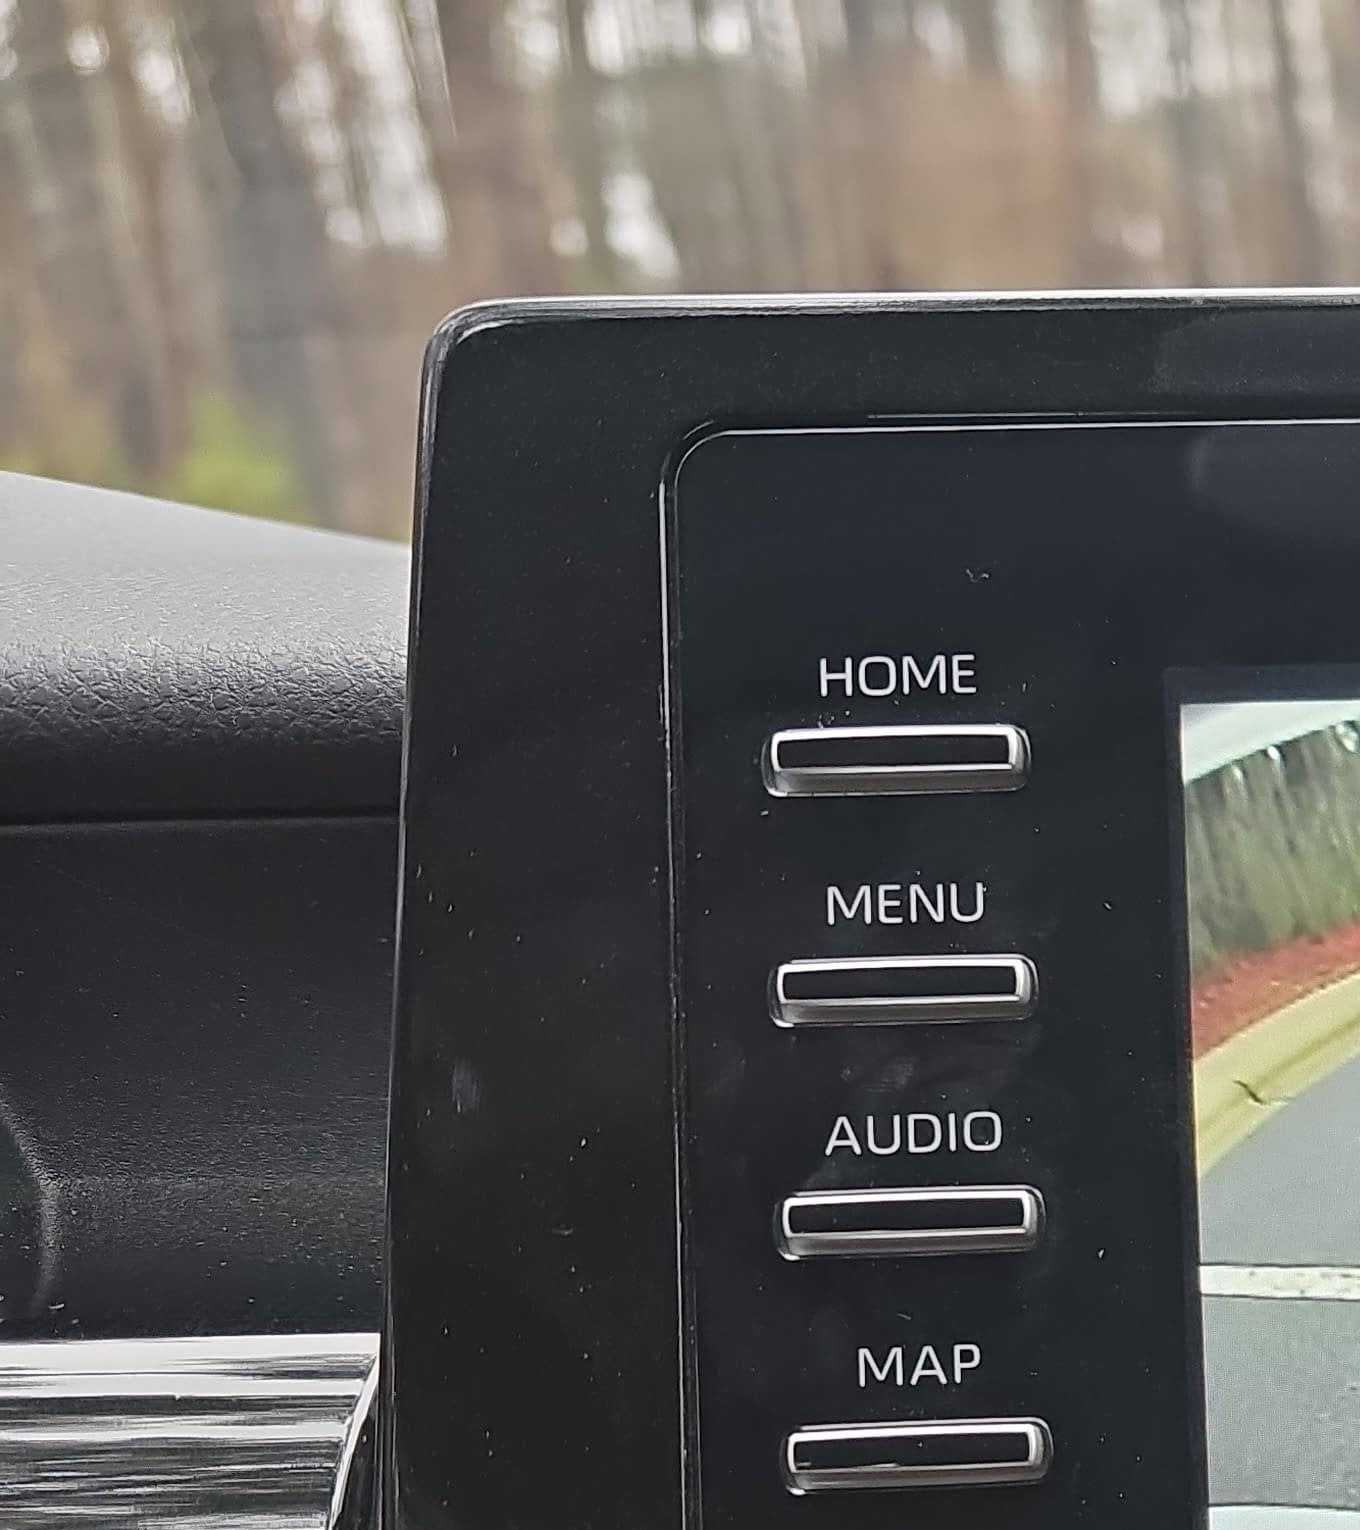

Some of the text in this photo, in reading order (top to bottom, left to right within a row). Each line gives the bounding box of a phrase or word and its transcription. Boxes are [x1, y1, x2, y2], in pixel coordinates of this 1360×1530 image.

[818, 653, 978, 697] HOME
[826, 882, 986, 925] MENU
[824, 1111, 1002, 1156] AUDIO
[857, 1344, 982, 1388] MAP
